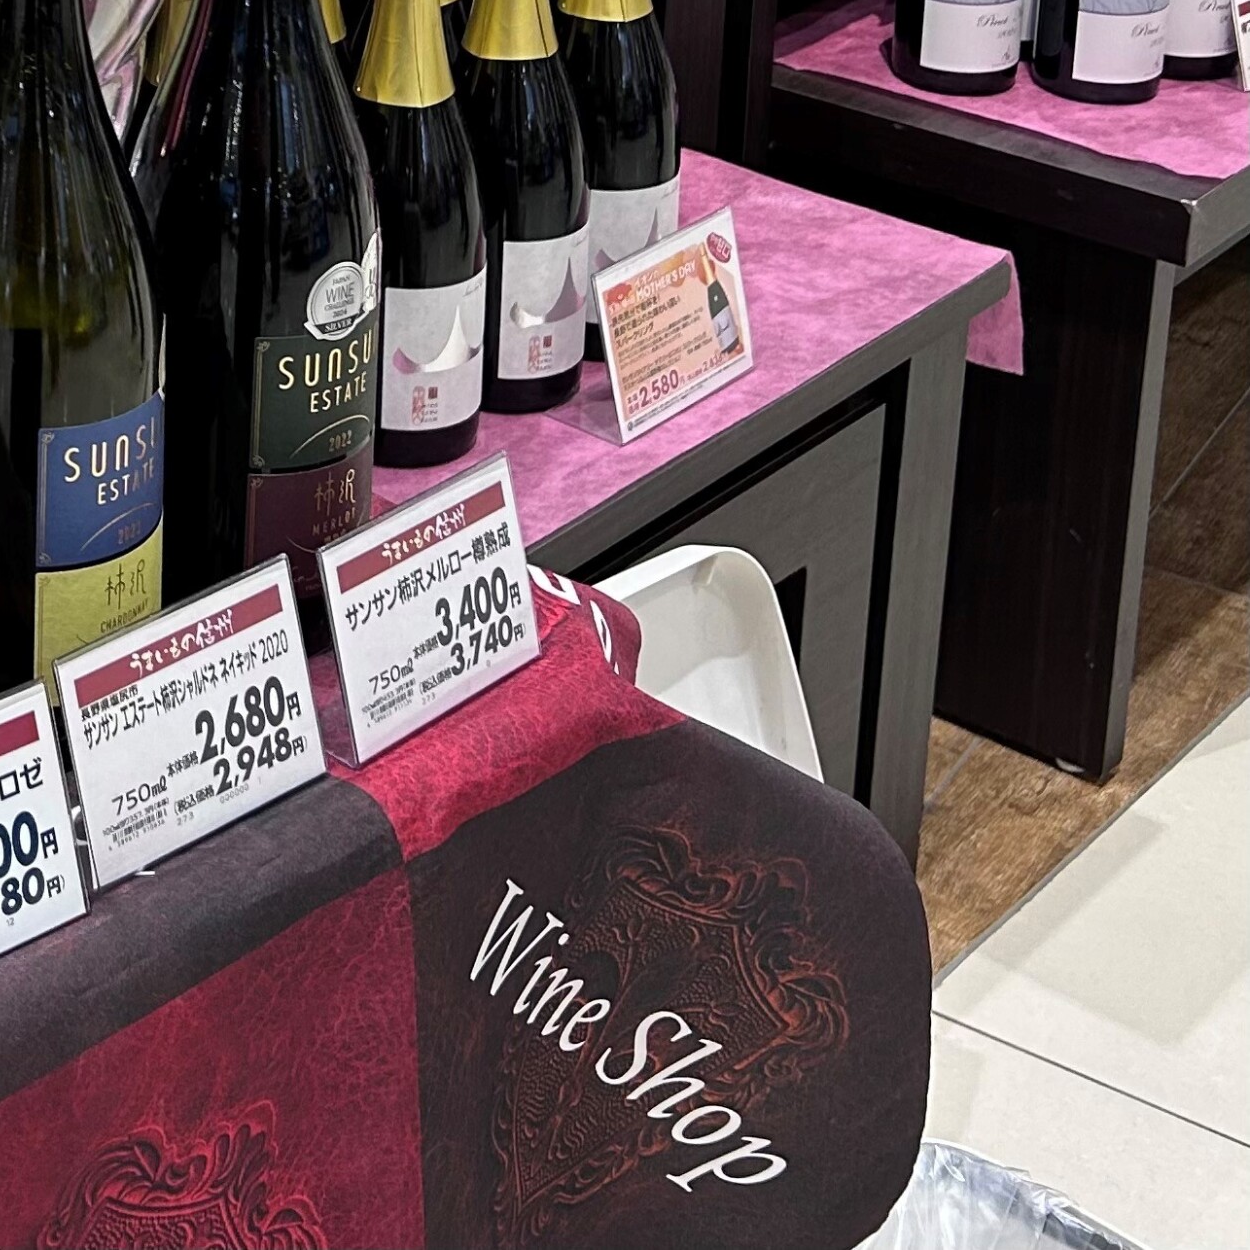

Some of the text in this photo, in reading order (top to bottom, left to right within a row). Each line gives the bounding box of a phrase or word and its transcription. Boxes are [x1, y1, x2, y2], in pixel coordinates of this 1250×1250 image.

[325, 281, 356, 304] WINE
[678, 261, 697, 281] DAY
[309, 371, 367, 414] ESTATE
[97, 456, 155, 505] ESTATE
[312, 507, 358, 537] MERLOT
[344, 521, 512, 632] サンサン柿沢メルロー樽熟成
[100, 600, 150, 633] CHARDONNAY
[435, 566, 523, 647] 3,400円
[83, 708, 120, 751] サンサン
[260, 628, 289, 665] 2020
[166, 750, 200, 778] 本体価格
[195, 675, 303, 765] 2,680円
[467, 879, 790, 1194] Wine Shop
